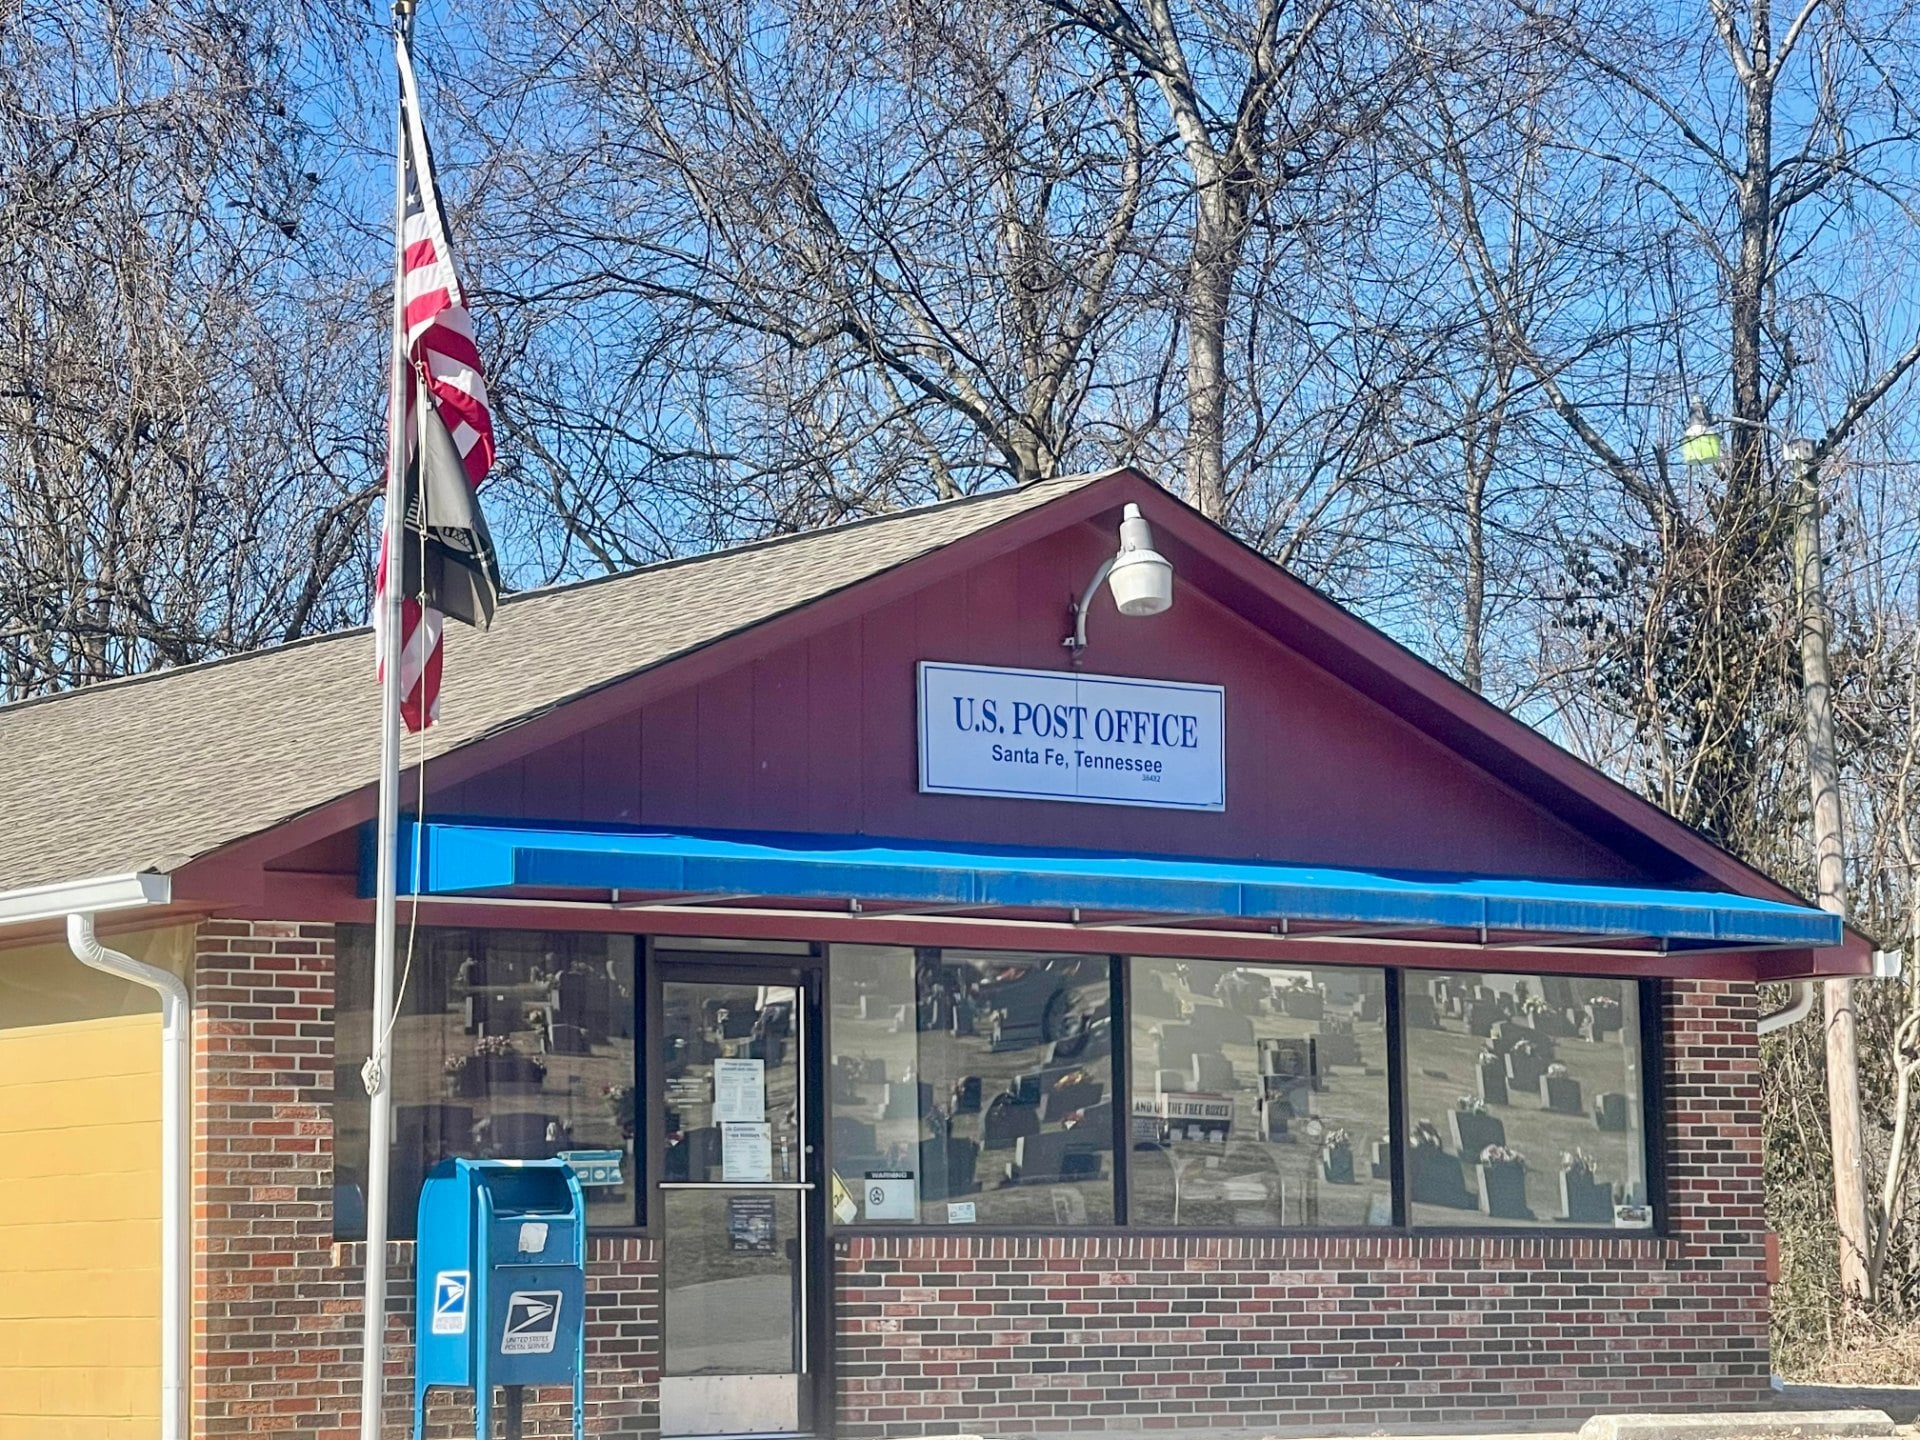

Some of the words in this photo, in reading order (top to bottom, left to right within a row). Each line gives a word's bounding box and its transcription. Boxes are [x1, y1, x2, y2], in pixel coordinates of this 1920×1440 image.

[953, 696, 1005, 734] U.S.
[1012, 701, 1088, 740] POST
[1094, 708, 1198, 748] OFFICE
[992, 744, 1039, 765] Santa
[1044, 748, 1069, 769] Fe,
[1074, 750, 1163, 774] Tennessee
[1168, 1102, 1183, 1115] THE
[1184, 1103, 1204, 1115] FREE
[1205, 1104, 1229, 1117] BOXES
[871, 1171, 908, 1179] WARNING
[527, 1342, 550, 1350] SERVICE
